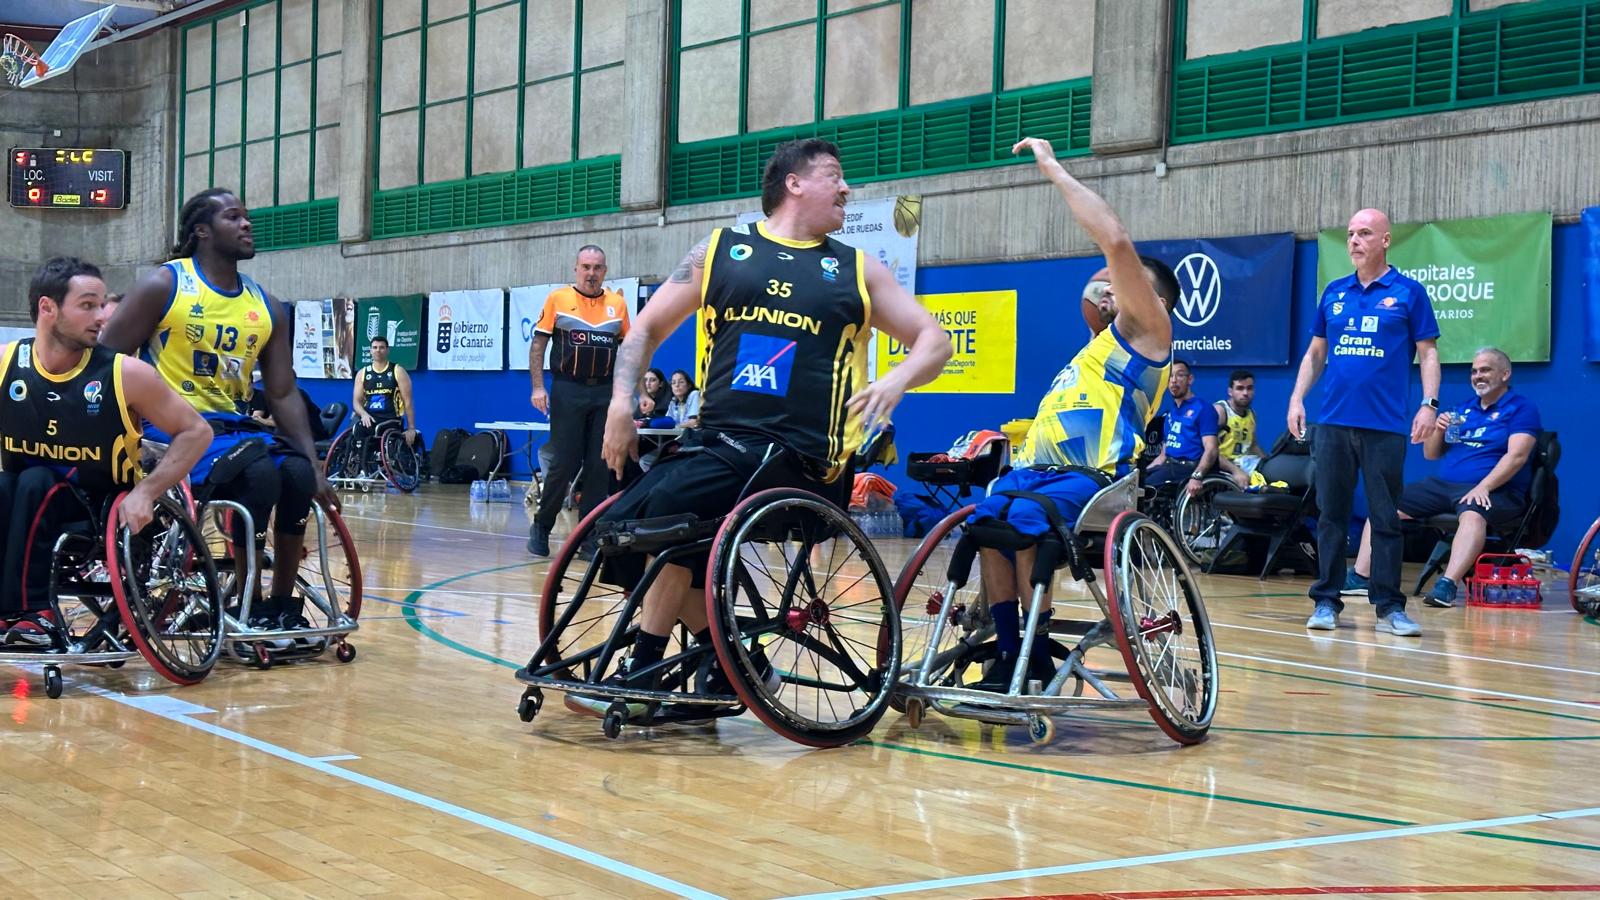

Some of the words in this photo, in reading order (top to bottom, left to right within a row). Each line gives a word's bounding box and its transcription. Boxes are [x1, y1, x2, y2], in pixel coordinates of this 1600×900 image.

[24, 169, 46, 181] LOC.
[88, 170, 115, 182] VISIT.
[847, 225, 855, 234] DE
[856, 223, 883, 233] RUEDAS
[766, 279, 793, 298] 35
[954, 310, 976, 326] QUE
[1434, 309, 1474, 320] TARIOS
[213, 323, 239, 353] 13
[460, 335, 494, 348] Canarias
[1339, 334, 1372, 346] Gran
[1334, 345, 1385, 358] Canaria
[731, 363, 778, 391] AXA
[46, 419, 58, 436] 5
[4, 436, 101, 462] ILUNION
